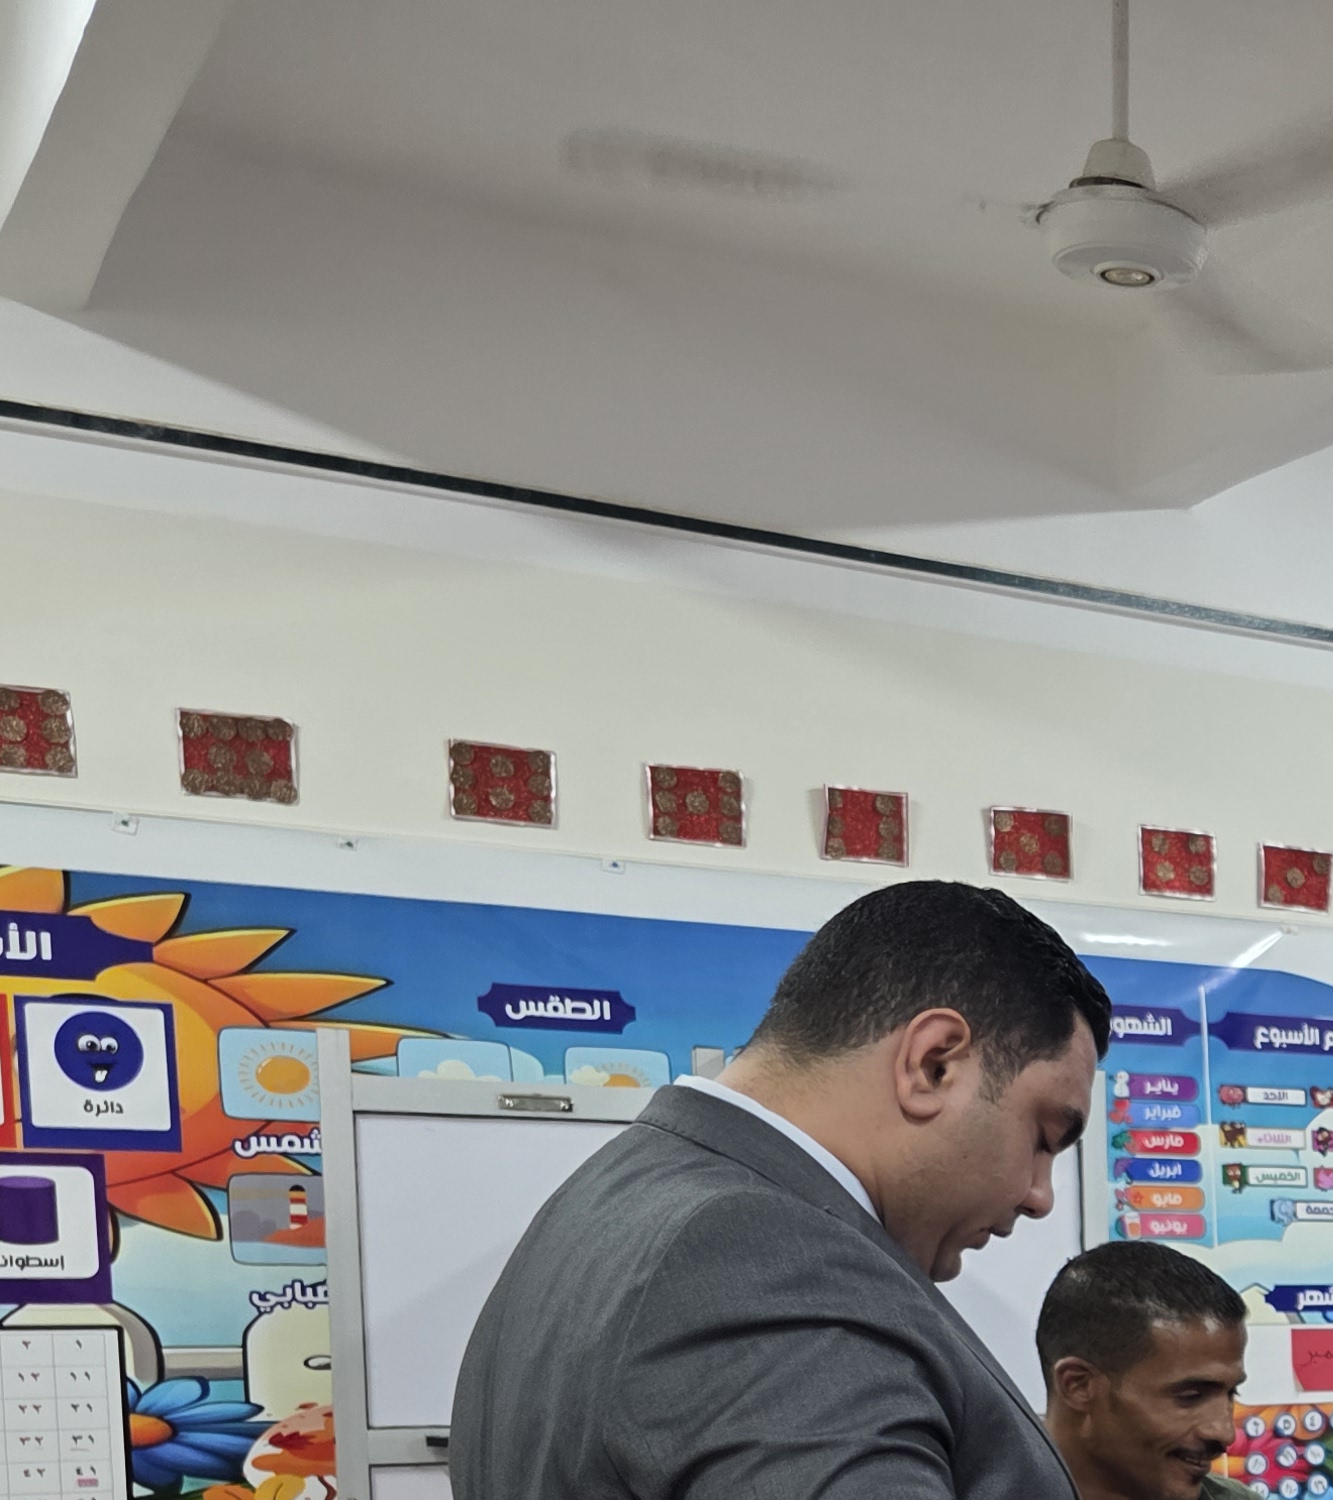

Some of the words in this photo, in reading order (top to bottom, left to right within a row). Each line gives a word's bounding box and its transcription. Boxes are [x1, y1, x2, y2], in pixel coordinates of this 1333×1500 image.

[0, 922, 52, 961] الأ
[505, 993, 611, 1022] الطقس
[1110, 1013, 1172, 1038] الشهو
[1255, 1023, 1320, 1049] الأسبوع
[1145, 1078, 1179, 1095] يناير
[83, 1099, 124, 1116] دائرة
[1144, 1104, 1181, 1121] فبراير
[234, 1129, 321, 1157] شمس
[1144, 1134, 1184, 1150] مارس
[1255, 1172, 1300, 1184] الخميس
[1152, 1192, 1182, 1208] مايو
[1150, 1219, 1188, 1235] يونيو
